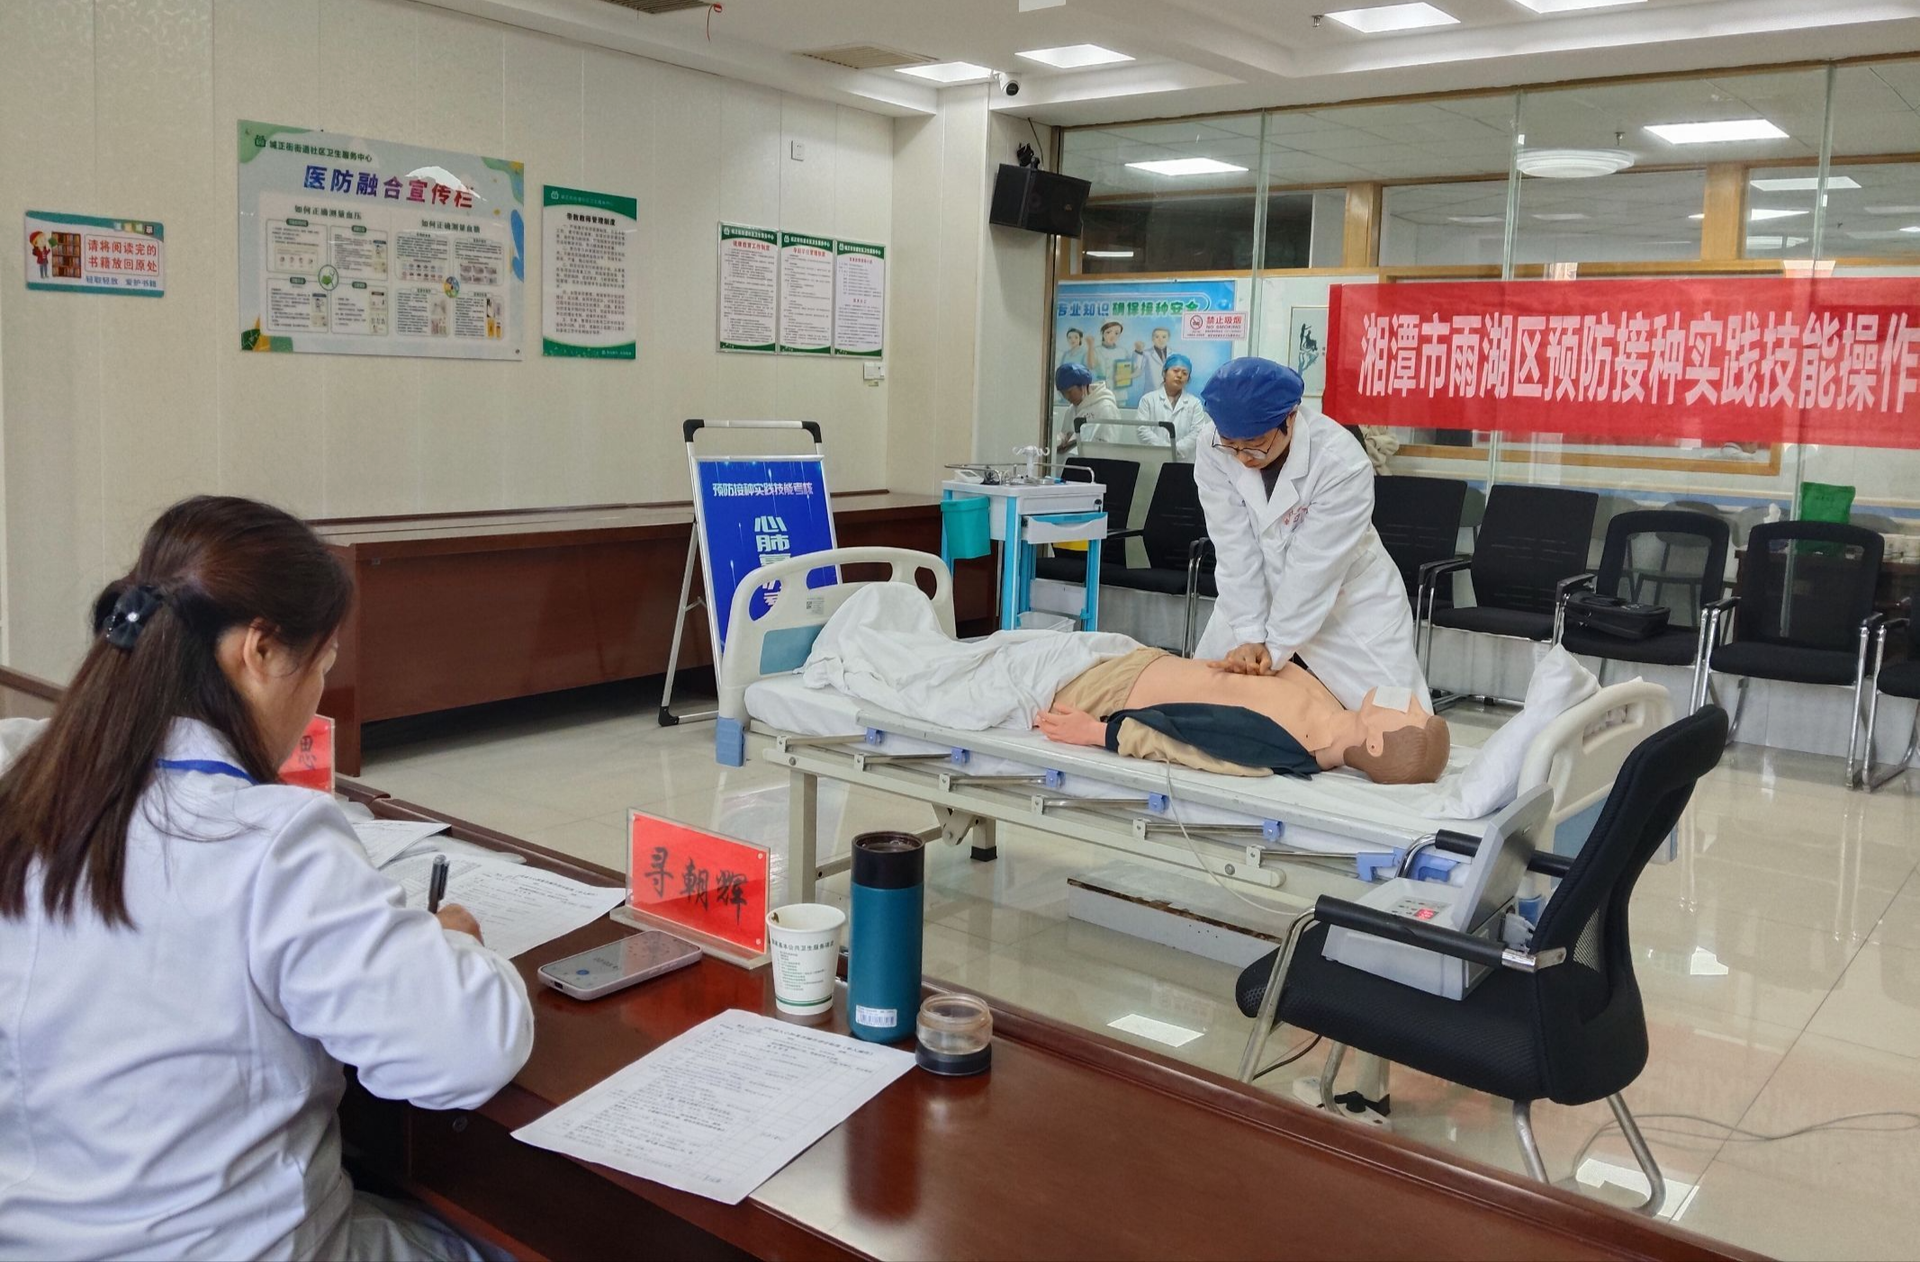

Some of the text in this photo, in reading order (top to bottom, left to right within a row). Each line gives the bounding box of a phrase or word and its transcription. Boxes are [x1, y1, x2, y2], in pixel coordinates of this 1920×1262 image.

[303, 165, 473, 209] 医防融合宣传栏
[294, 205, 362, 221] 如何正确测量血压
[87, 239, 157, 257] 请将阅读完的
[88, 255, 158, 273] 书籍放回原处
[1112, 301, 1199, 316] 确保接种安全
[1205, 315, 1243, 325] 禁止吸烟
[1357, 310, 1919, 413] 湘潭市雨湖区预防接种实践技能操作
[712, 482, 814, 497] 预防接种实践技能考核
[644, 846, 748, 926] 寻朝辉
